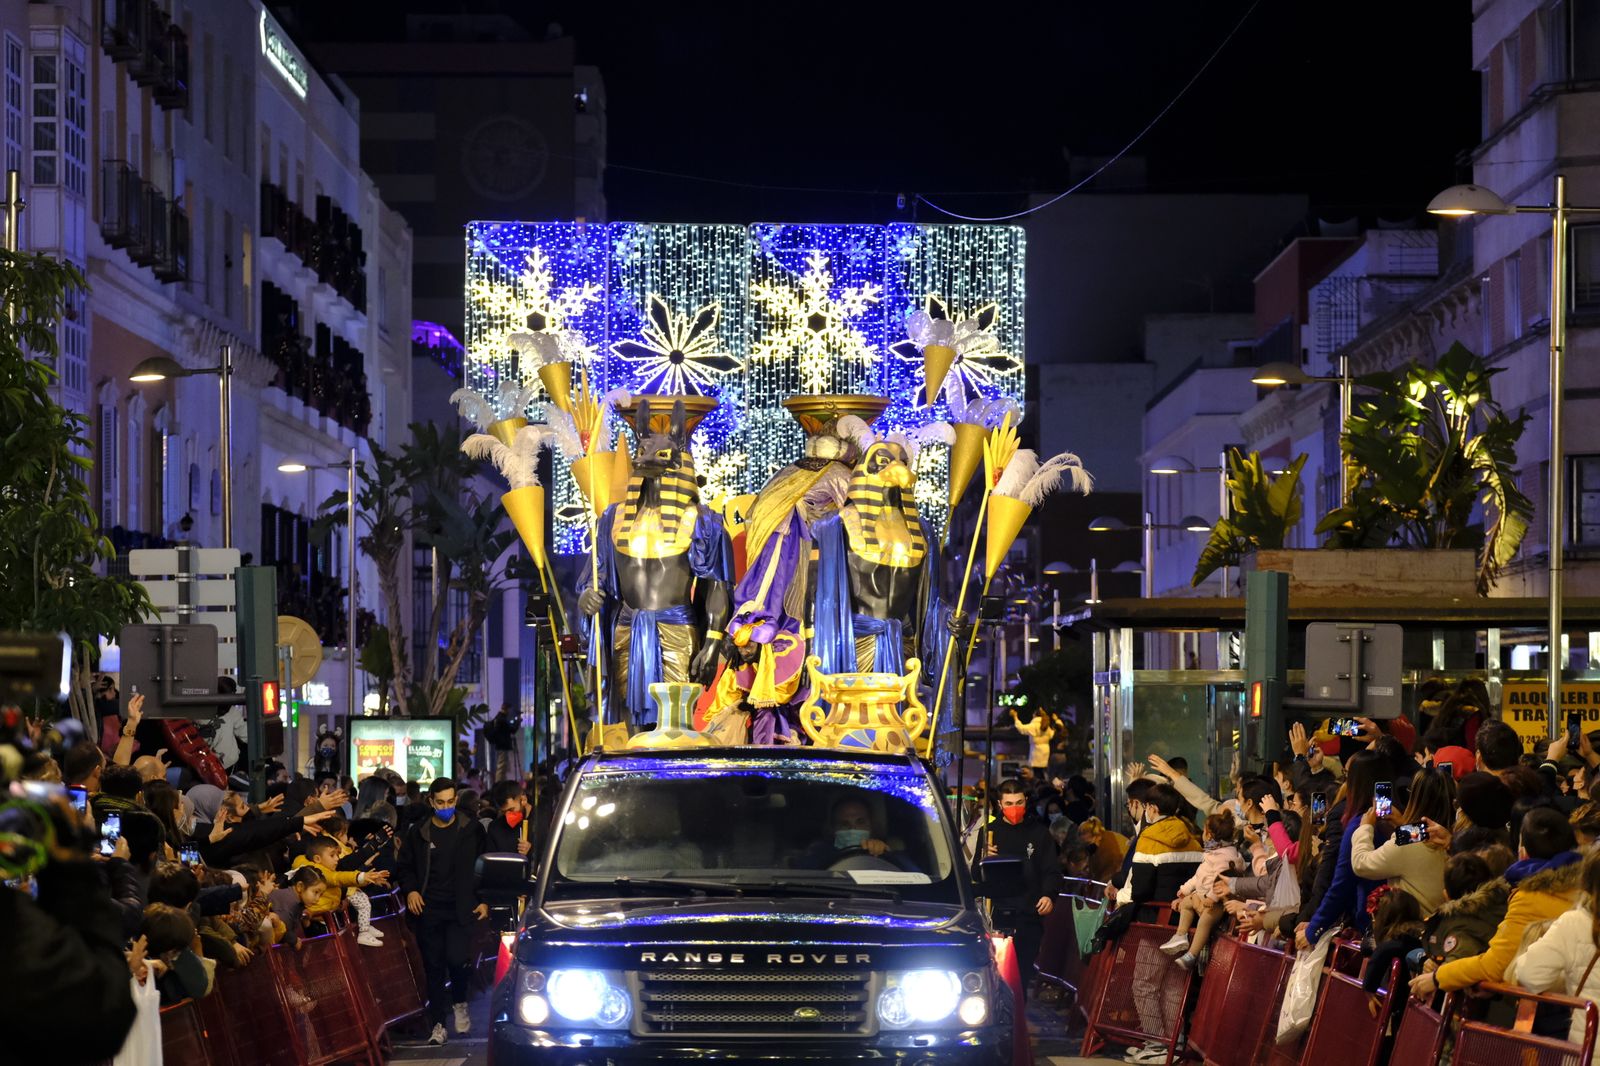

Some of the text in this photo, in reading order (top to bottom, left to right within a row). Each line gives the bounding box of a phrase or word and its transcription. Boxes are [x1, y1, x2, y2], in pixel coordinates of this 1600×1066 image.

[1509, 692, 1588, 705] ALQULER
[1512, 709, 1599, 721] TRATRO
[641, 952, 871, 964] RANGE ROVER
